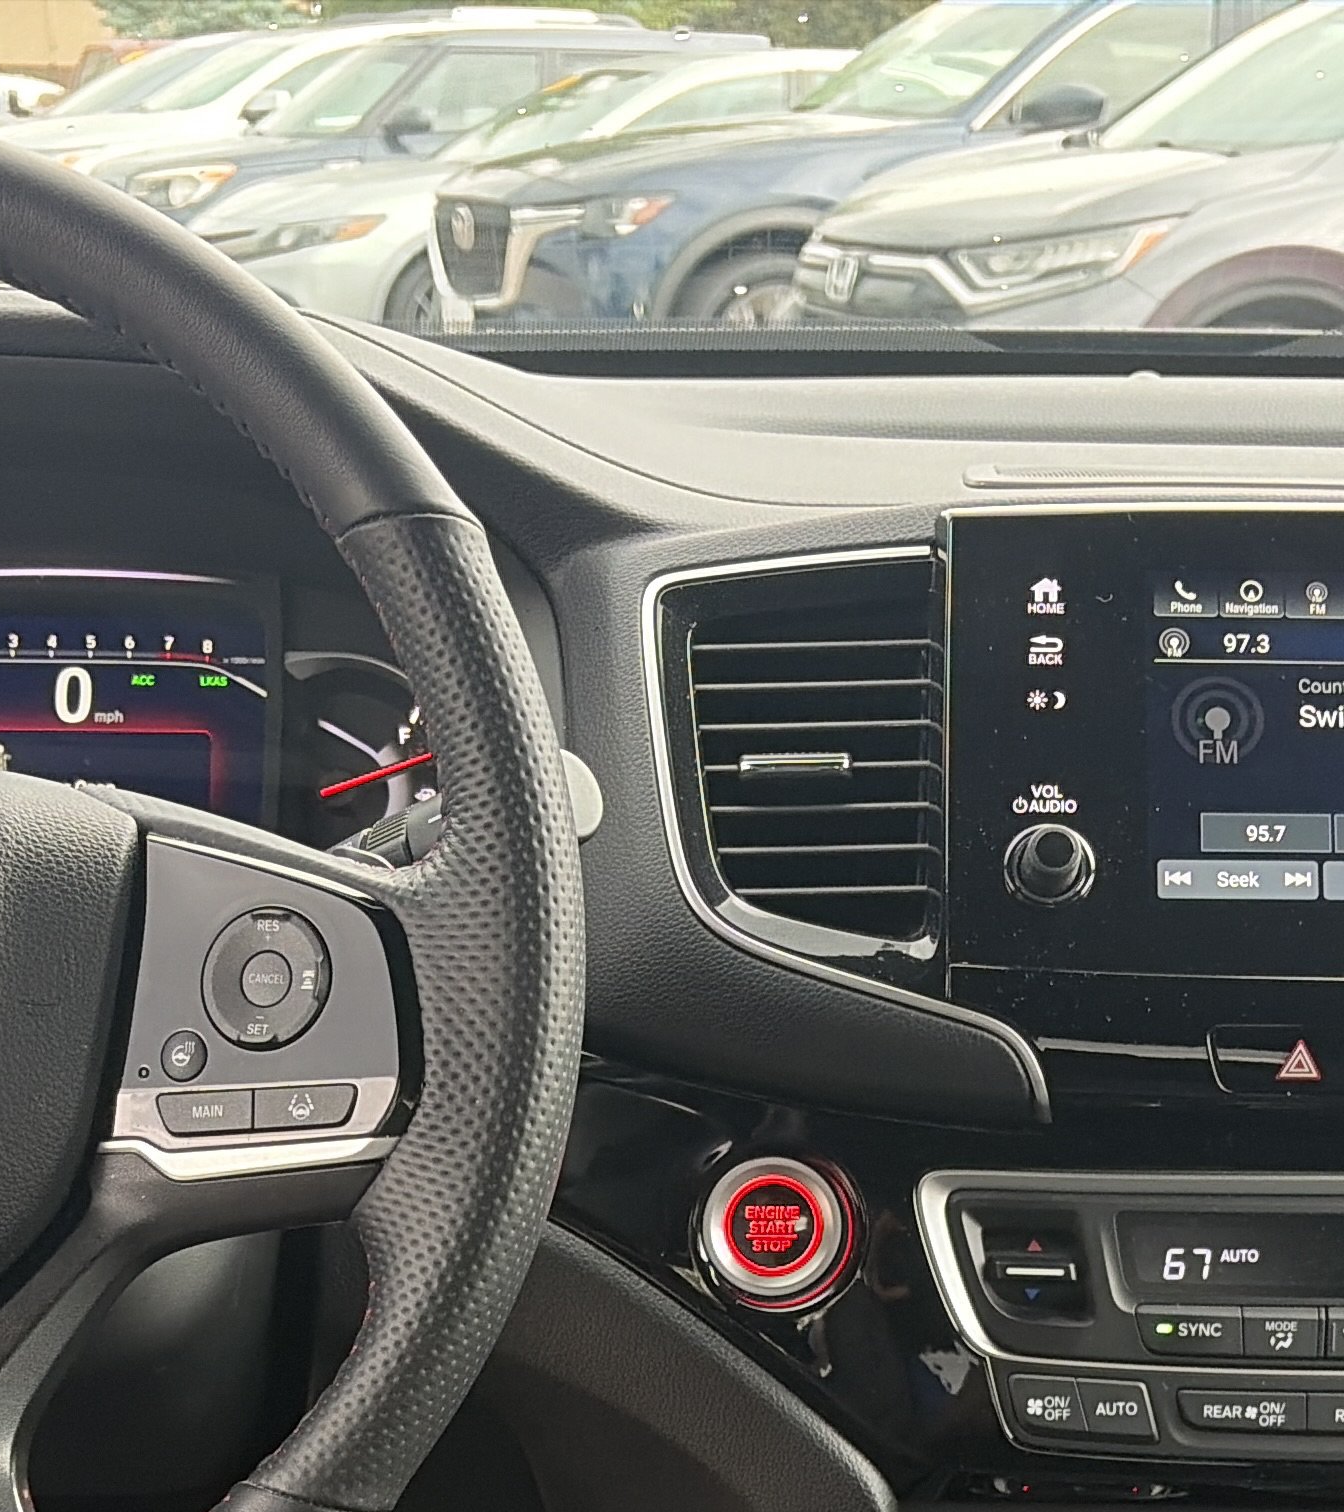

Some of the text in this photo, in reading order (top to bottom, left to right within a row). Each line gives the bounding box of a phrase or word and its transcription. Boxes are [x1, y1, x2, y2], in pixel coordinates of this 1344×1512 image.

[1027, 602, 1066, 615] HOME
[1170, 602, 1203, 614] Phone
[1225, 602, 1279, 617] Navigation
[1309, 603, 1327, 615] FM
[8, 632, 19, 648] 3
[46, 634, 58, 649] 4
[85, 634, 97, 649] 5
[124, 634, 136, 650] 6
[163, 635, 175, 651] 7
[202, 639, 213, 654] 8
[1223, 633, 1270, 654] 97.3
[1028, 653, 1064, 666] BACK
[131, 674, 155, 686] ACC
[199, 675, 228, 688] LKAS
[54, 666, 93, 724] 0
[94, 709, 125, 724] mph
[398, 725, 412, 745] F
[1198, 740, 1239, 764] FM
[1030, 784, 1064, 799] VOL
[1028, 799, 1078, 814] AUDIO
[1245, 825, 1286, 843] 95.7
[1216, 871, 1260, 888] Seek
[256, 919, 280, 933] RES
[248, 972, 286, 985] CANCEL
[246, 1023, 269, 1036] SET
[191, 1104, 224, 1119] MAIN
[744, 1205, 801, 1220] ENGINE
[748, 1220, 796, 1234] START
[751, 1239, 792, 1252] STOP
[1162, 1248, 1259, 1281] 67 AUTO
[1178, 1323, 1223, 1338] SYNC
[1264, 1321, 1298, 1332] MODE
[1044, 1396, 1071, 1408] ON/
[1095, 1402, 1138, 1416] AUTO
[1259, 1402, 1286, 1414] ON/
[1044, 1408, 1071, 1421] OFF
[1203, 1404, 1242, 1419] REAR
[1258, 1414, 1286, 1427] OFF
